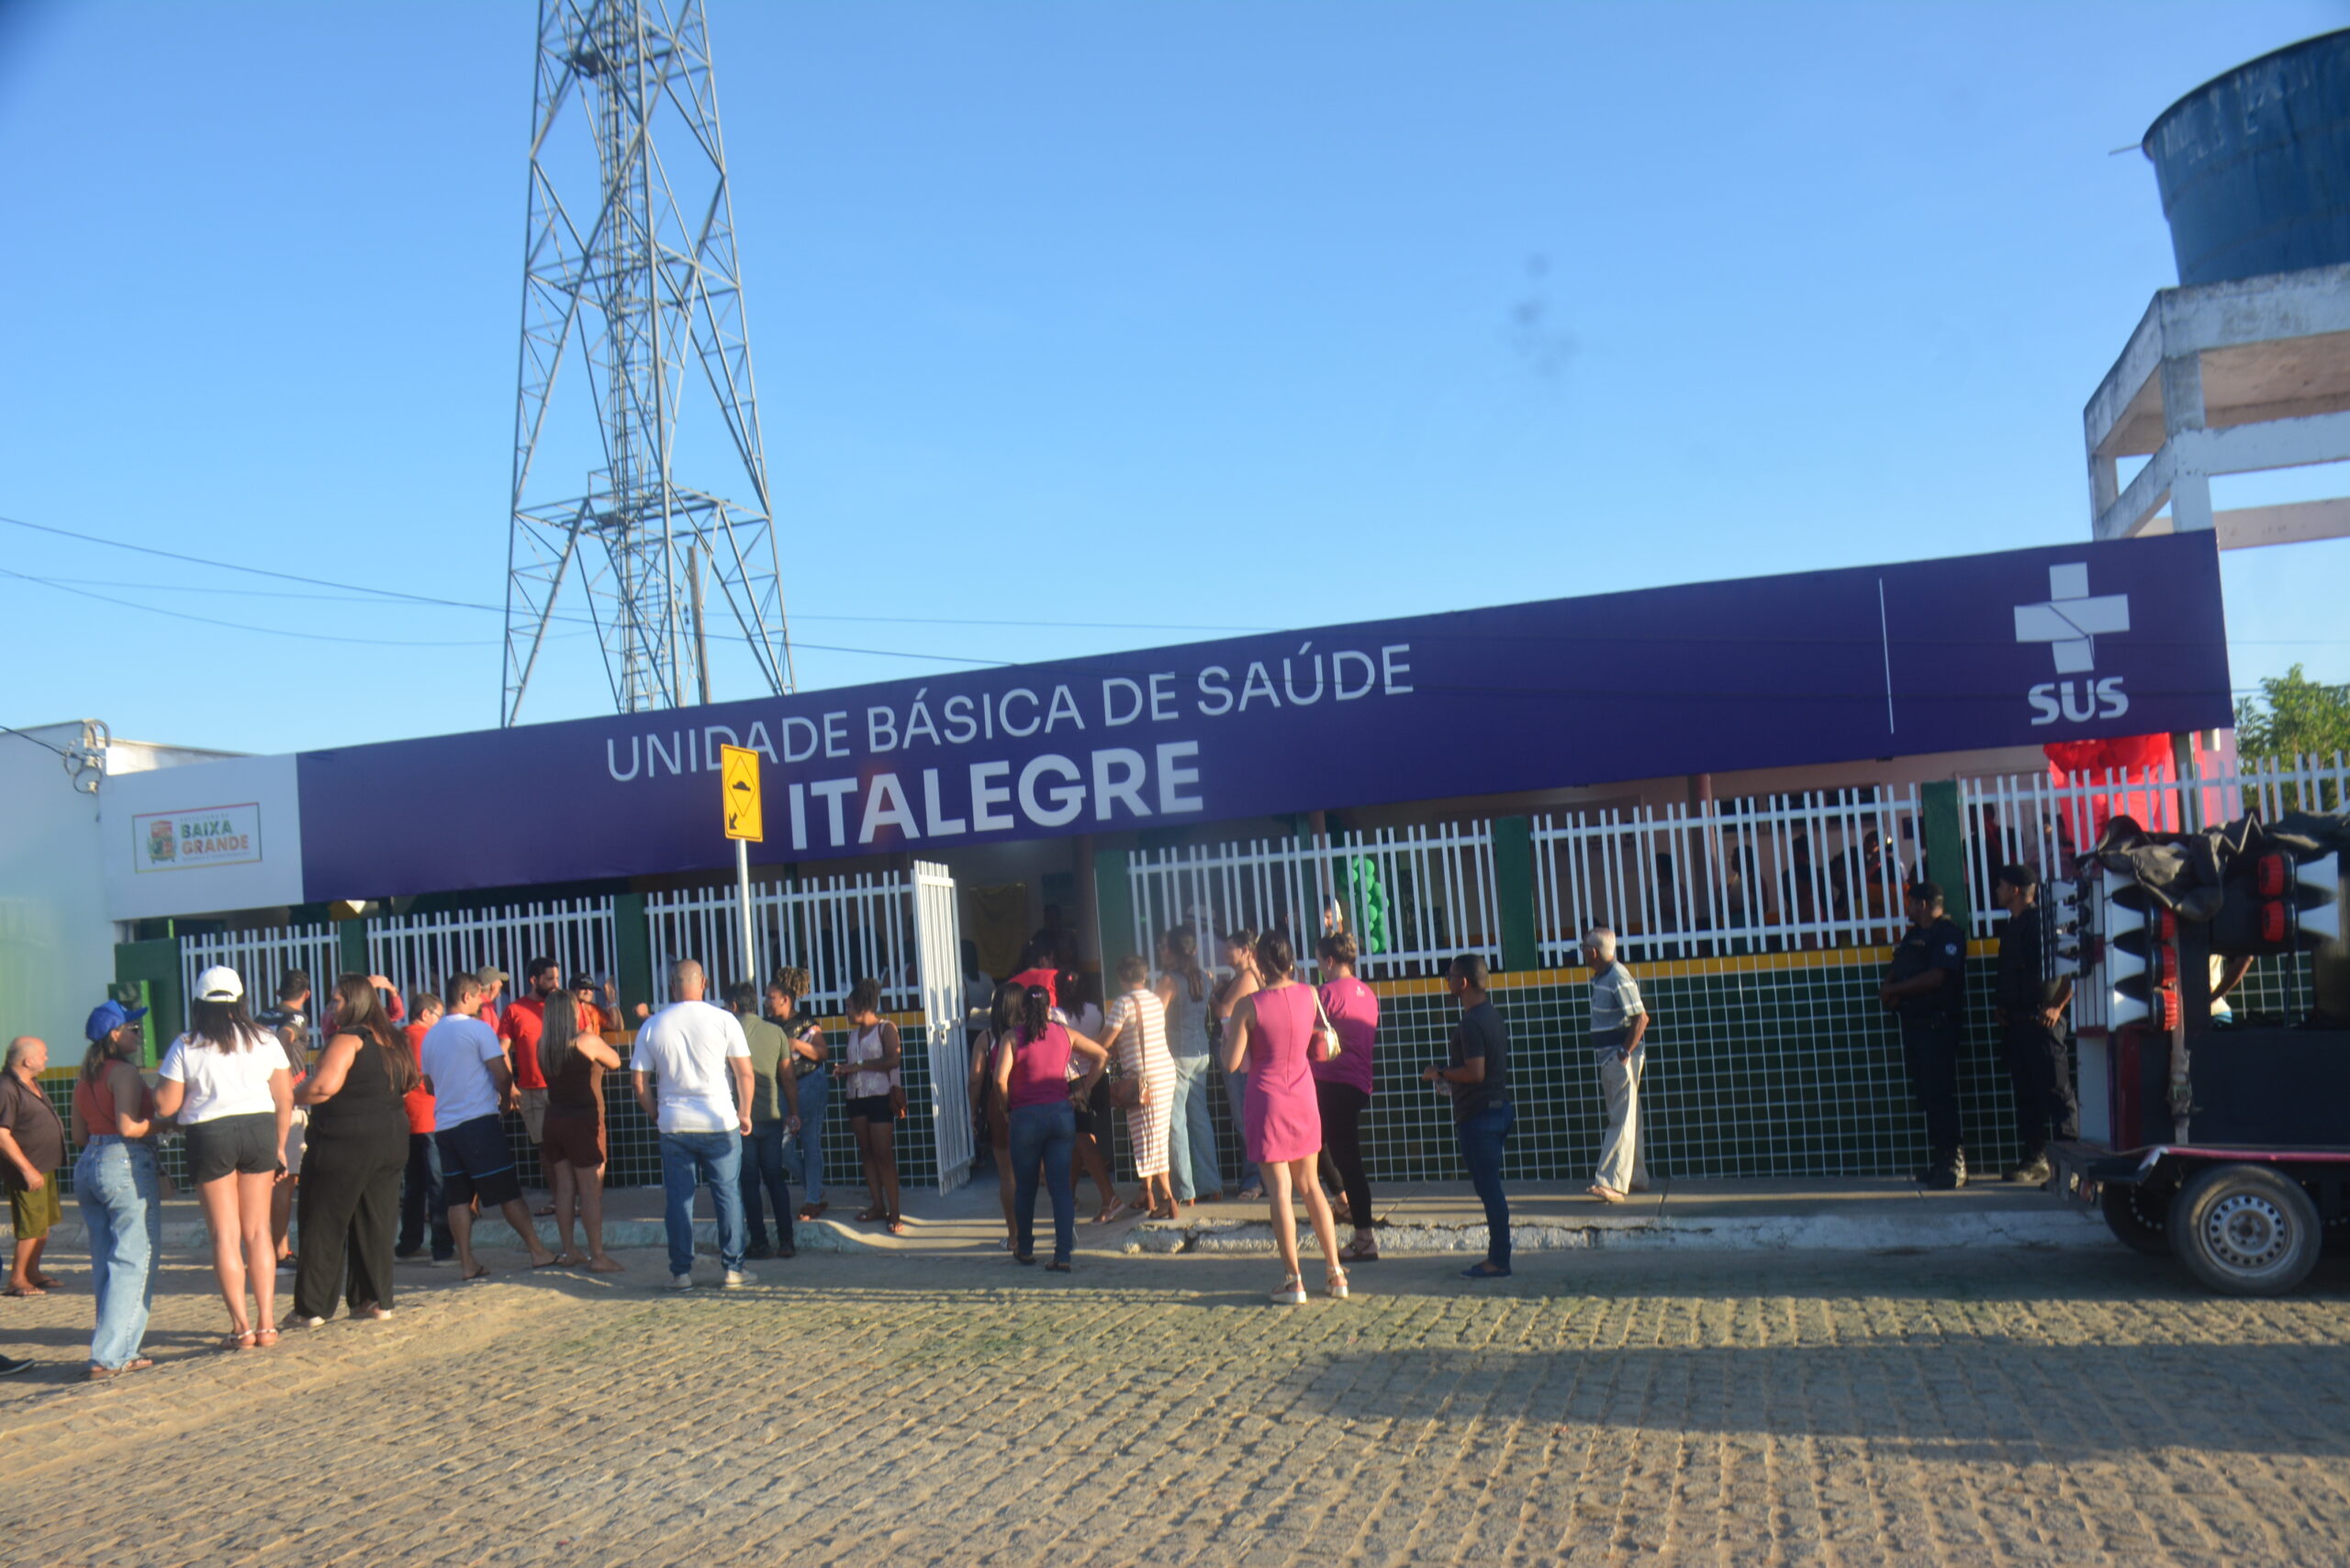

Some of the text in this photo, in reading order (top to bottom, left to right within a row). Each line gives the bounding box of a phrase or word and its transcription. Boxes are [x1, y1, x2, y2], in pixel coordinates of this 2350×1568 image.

[607, 641, 1415, 782] UNIDADE BÁSICA DE SAÚDE
[2028, 677, 2129, 725] SUS
[789, 740, 1203, 850] ITALEGRE
[181, 819, 233, 839] BAIXA
[181, 834, 249, 856] GRANDE
